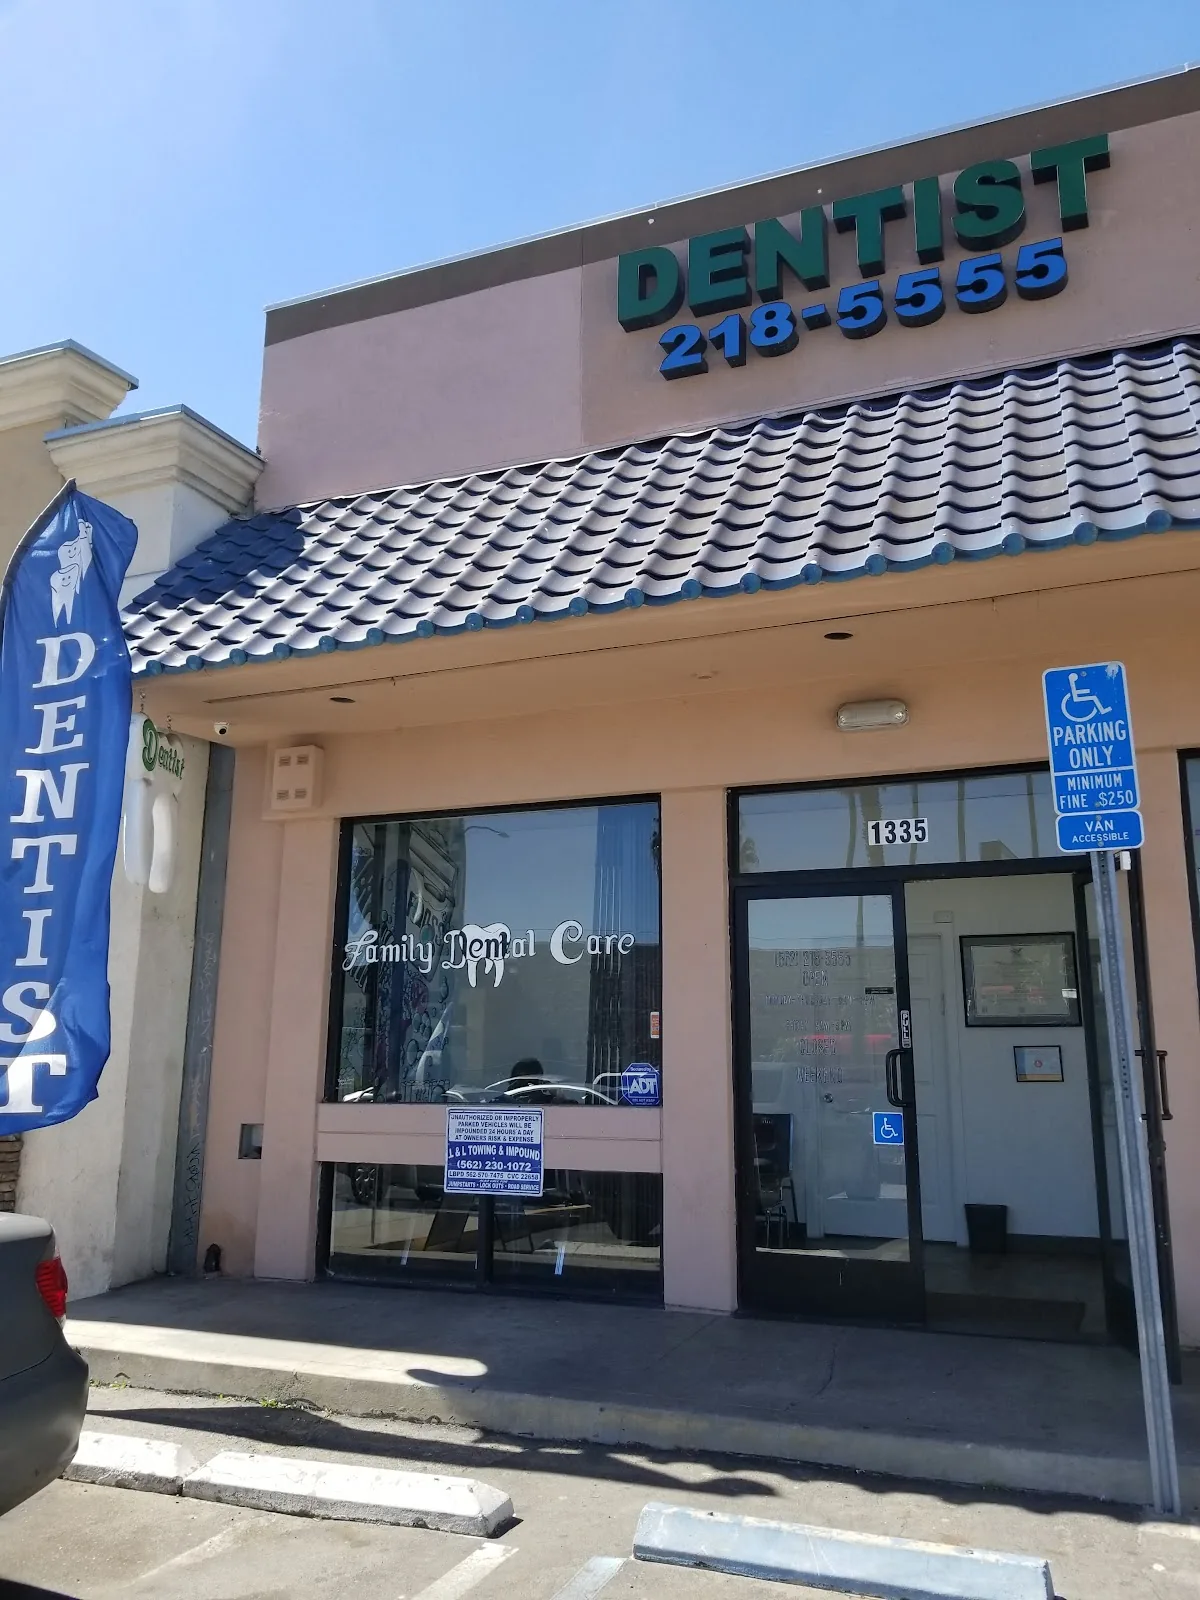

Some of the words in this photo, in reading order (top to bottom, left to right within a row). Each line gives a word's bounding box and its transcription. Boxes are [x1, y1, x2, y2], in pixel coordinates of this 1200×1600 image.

[617, 133, 1110, 332] DENTIST
[659, 237, 1068, 381] 218-5555
[1053, 719, 1127, 747] PARKING
[142, 718, 184, 780] Dentist
[1069, 745, 1114, 769] ONLY
[1067, 772, 1123, 792] MINIMUM
[1059, 794, 1088, 810] FINE
[1098, 789, 1134, 807] $250
[871, 819, 926, 844] 1335
[1084, 820, 1114, 833] VAN
[1071, 832, 1130, 843] ACCESSIBLE
[0, 632, 95, 1113] DENTIST
[342, 930, 433, 974] Family
[441, 928, 537, 970] Dental
[550, 919, 635, 965] Care
[802, 970, 828, 987] OPEN
[629, 1078, 657, 1095] ADT
[448, 1148, 454, 1159] L
[455, 1146, 460, 1157] &
[461, 1145, 467, 1156] L
[467, 1144, 497, 1156] TOWING
[498, 1145, 504, 1156] &
[505, 1145, 541, 1161] IMPOUND
[456, 1160, 482, 1170] (562)
[484, 1161, 531, 1171] 230-1072
[447, 1180, 476, 1188] JUMPSTARTS
[520, 1183, 539, 1191] SERVICE
